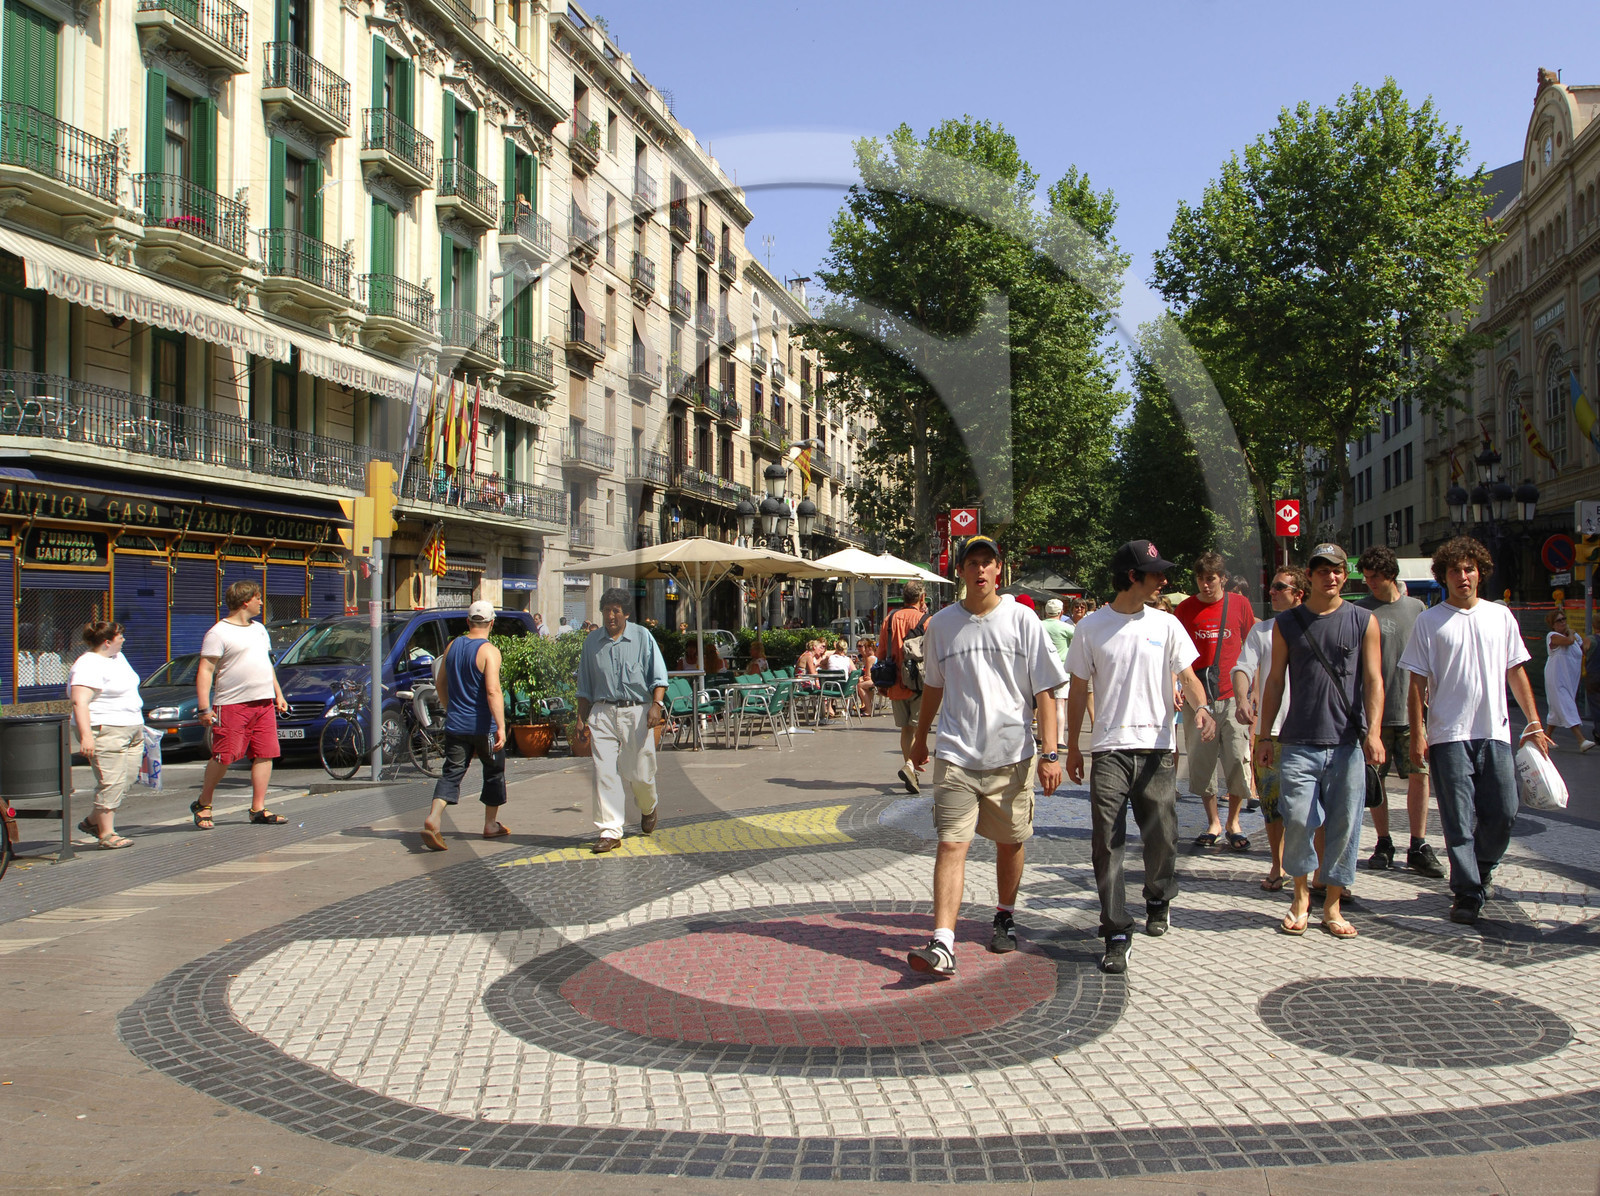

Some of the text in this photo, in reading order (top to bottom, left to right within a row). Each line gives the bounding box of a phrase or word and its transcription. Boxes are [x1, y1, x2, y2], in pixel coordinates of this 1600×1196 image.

[50, 270, 249, 346] HOTEL INTERNACIONAL
[332, 362, 445, 410] HOTEL INTERNAIOL
[467, 386, 489, 403] HOEL
[1, 488, 88, 518] ANTIGA
[106, 500, 160, 525] CASA
[1283, 508, 1293, 518] M
[959, 515, 968, 523] M
[39, 531, 95, 548] FUNDADA
[289, 730, 303, 738] DKB
